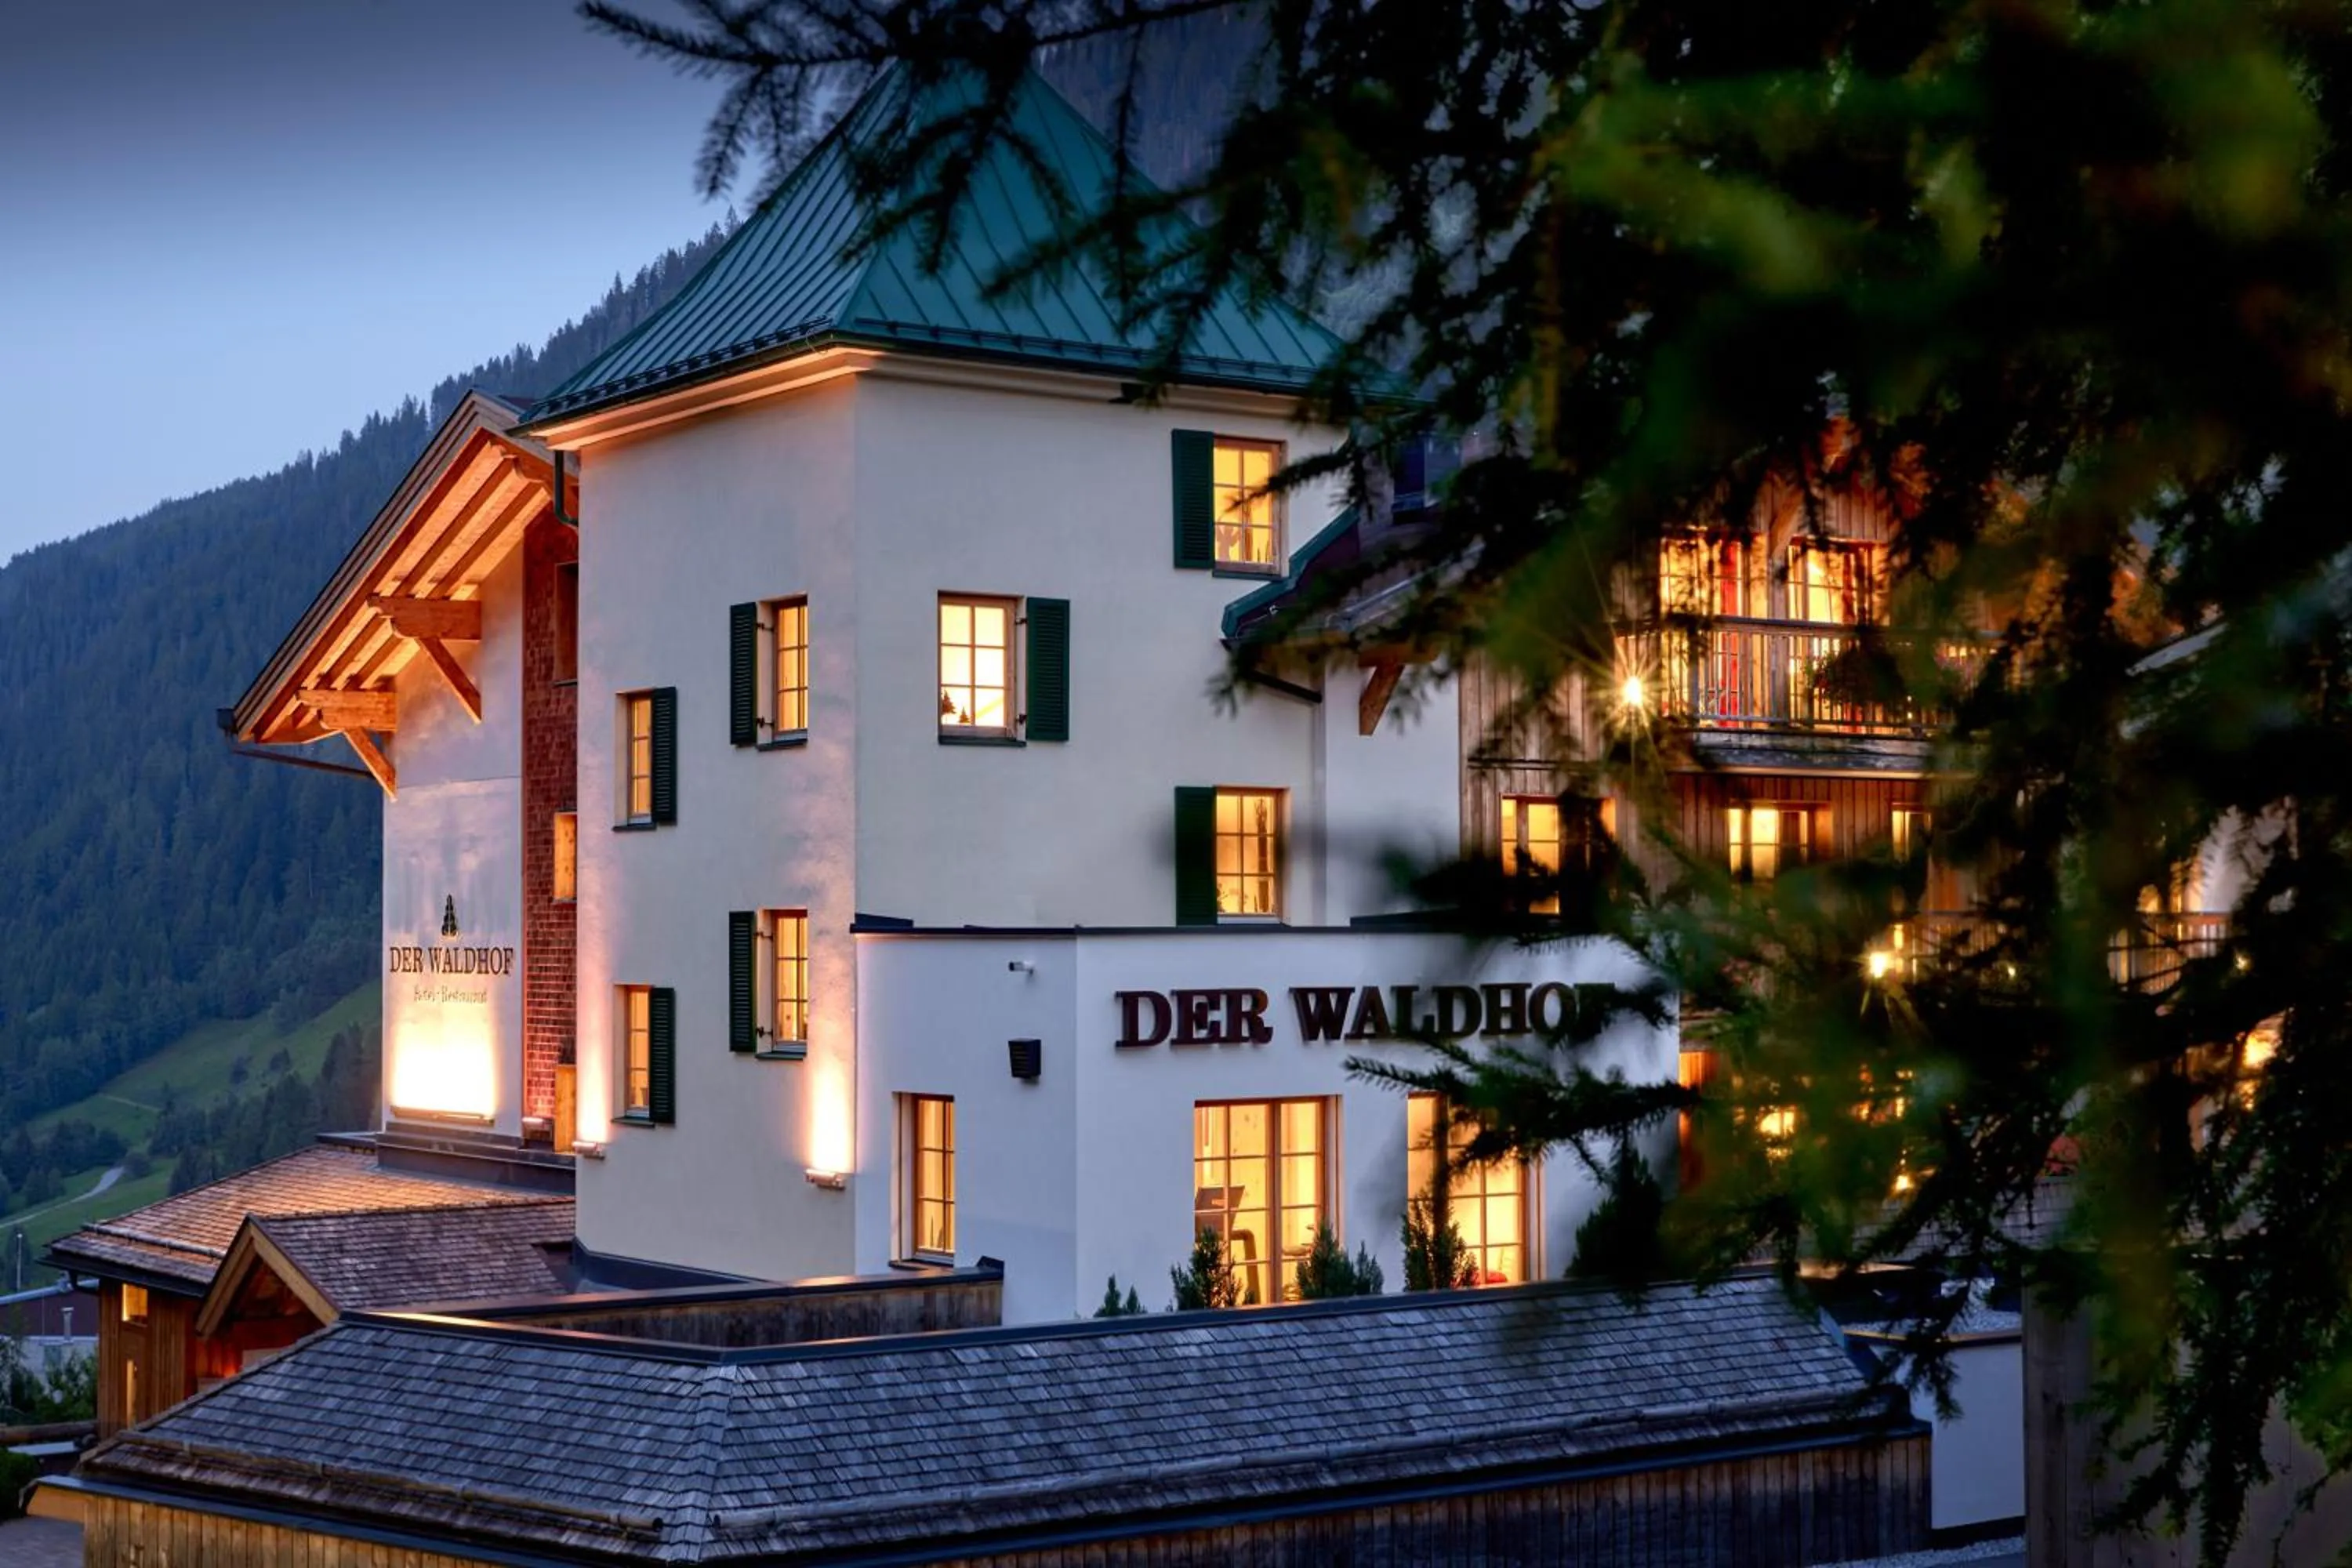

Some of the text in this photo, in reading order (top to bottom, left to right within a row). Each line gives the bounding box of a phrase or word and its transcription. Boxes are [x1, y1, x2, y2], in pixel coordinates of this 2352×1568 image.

[390, 946, 514, 975] DER WALDHOF
[1115, 988, 1272, 1047] DER
